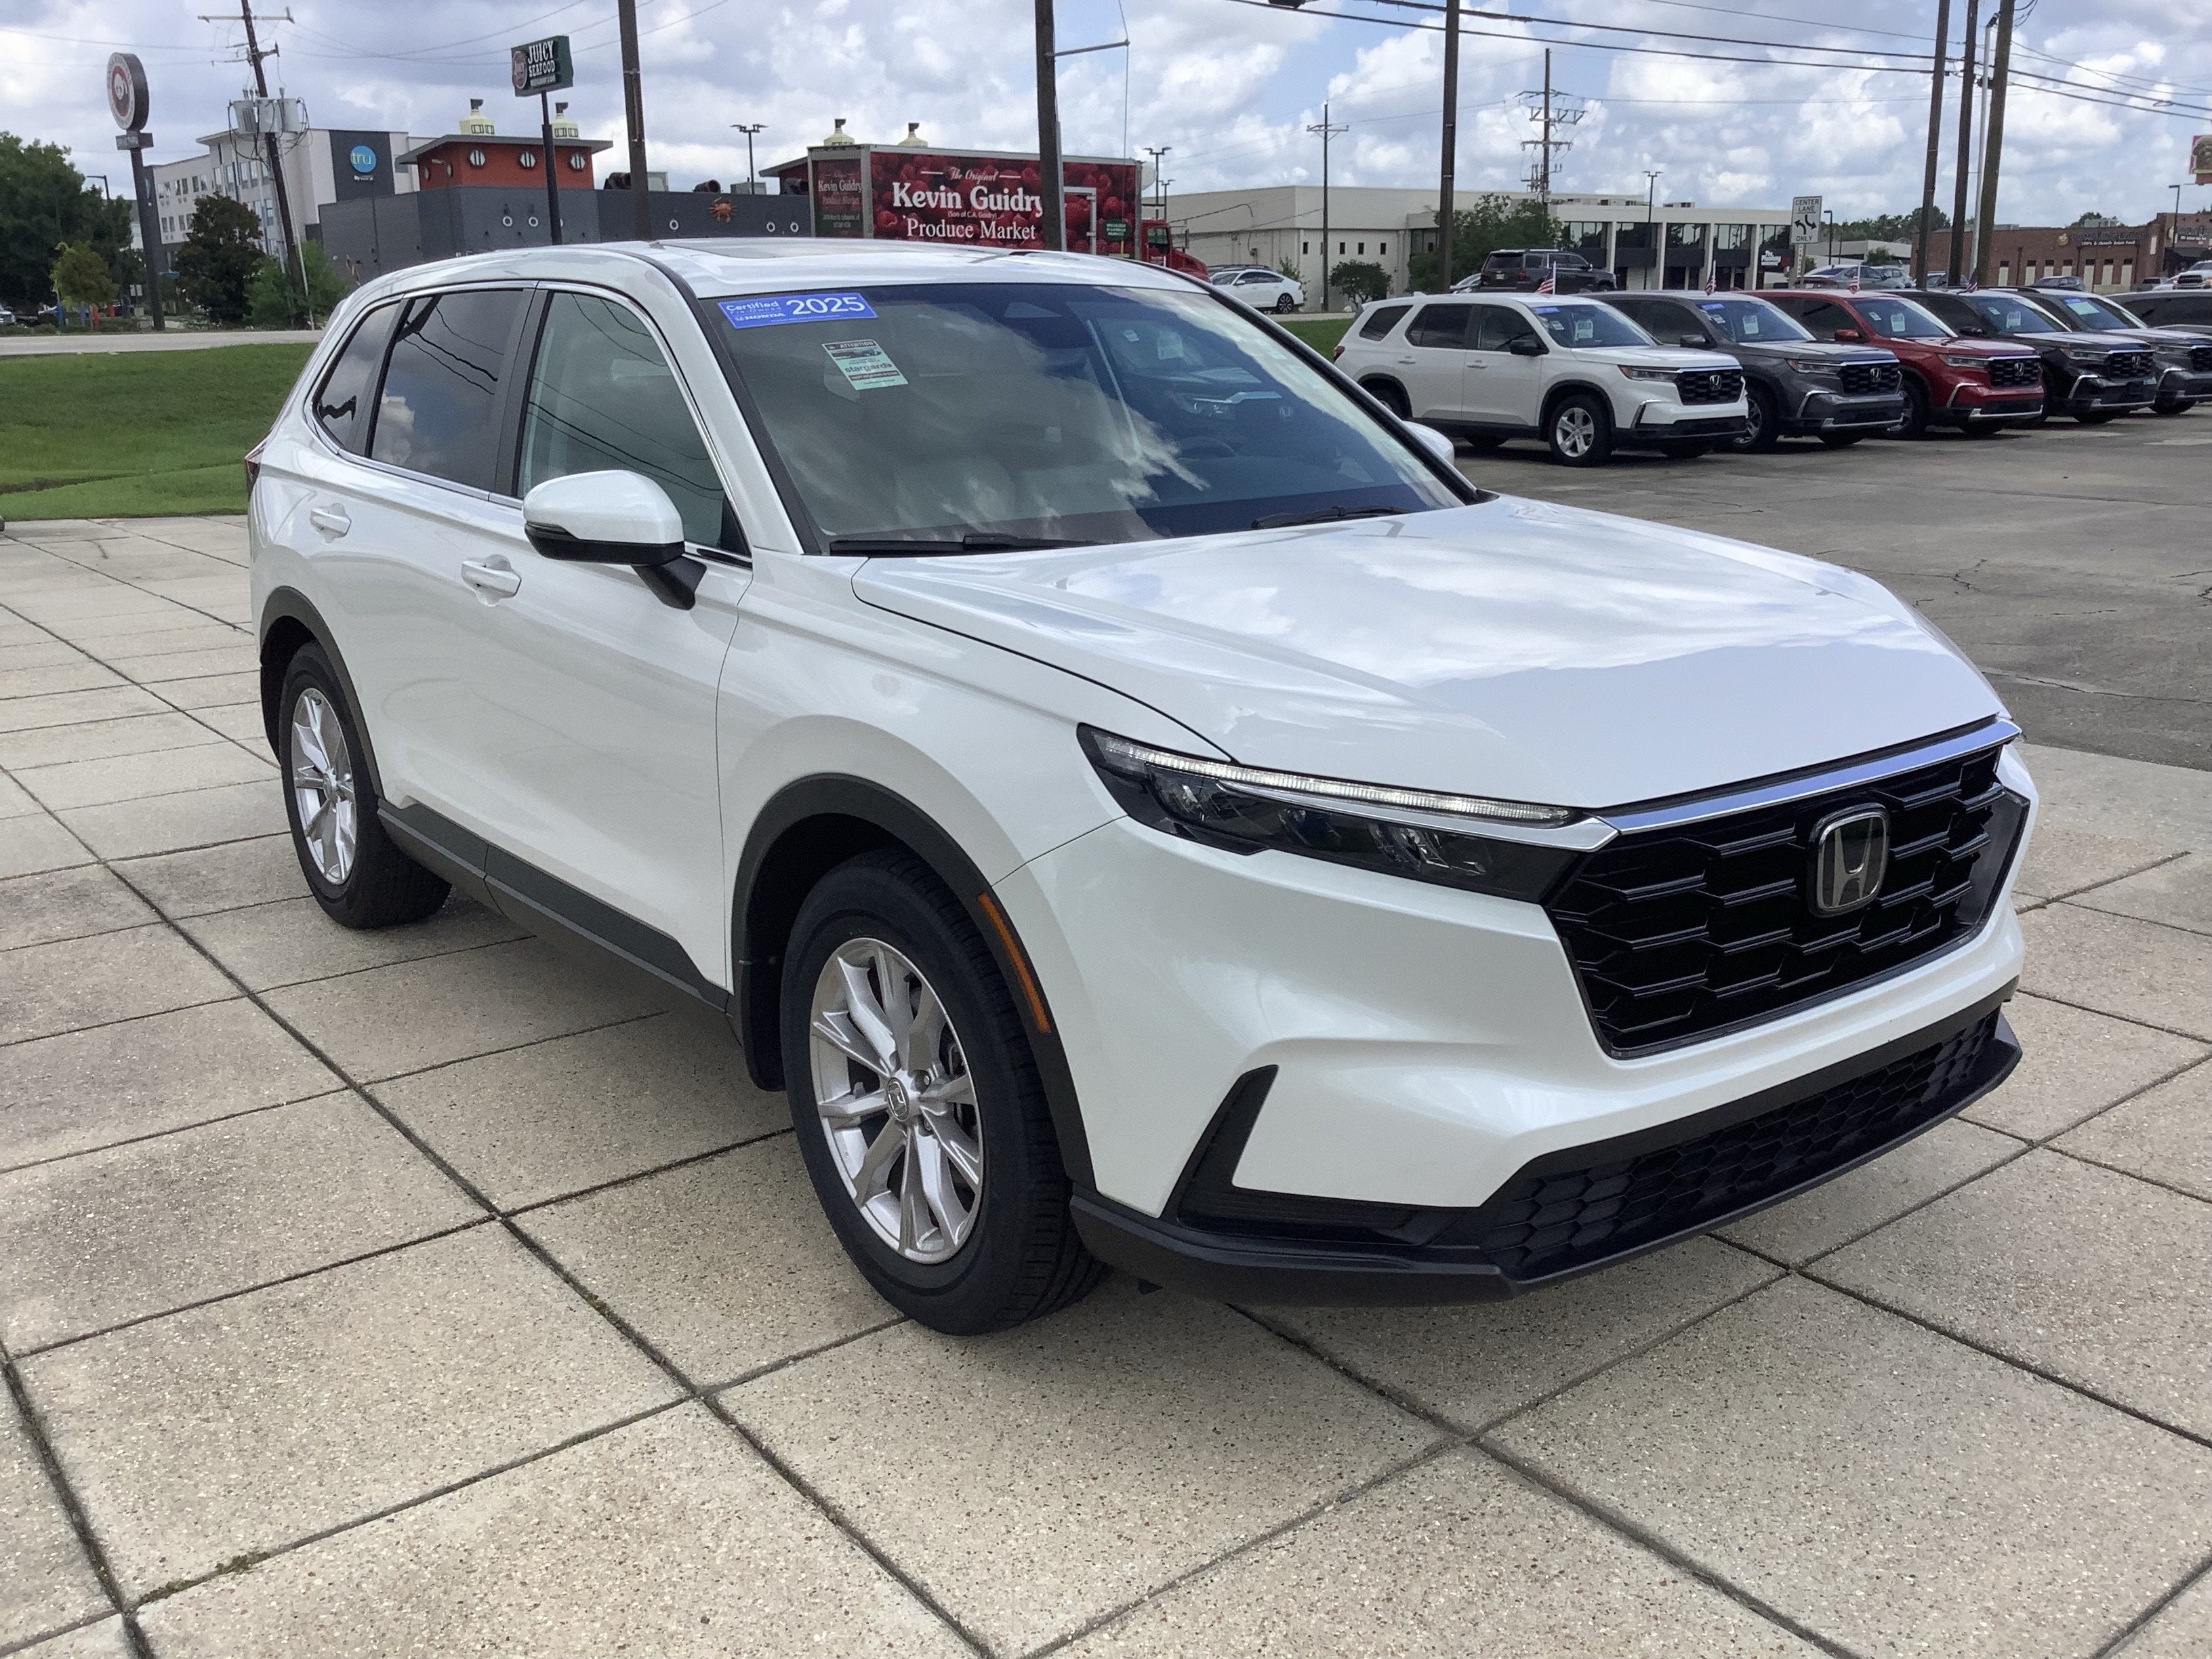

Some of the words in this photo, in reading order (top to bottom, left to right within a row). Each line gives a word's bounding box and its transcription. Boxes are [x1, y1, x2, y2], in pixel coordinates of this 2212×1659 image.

[528, 41, 554, 64] JUICY
[529, 60, 556, 77] SEAFOOD
[350, 151, 371, 165] tru
[949, 167, 962, 180] The
[965, 169, 999, 184] Original
[818, 180, 838, 192] Kevin
[892, 182, 962, 209] Kevin
[970, 185, 1043, 218] Guidry
[907, 218, 974, 237] Produce
[980, 220, 1036, 240] Market
[726, 301, 779, 312] Certified
[786, 297, 865, 315] 2025
[745, 312, 786, 321] HONDA
